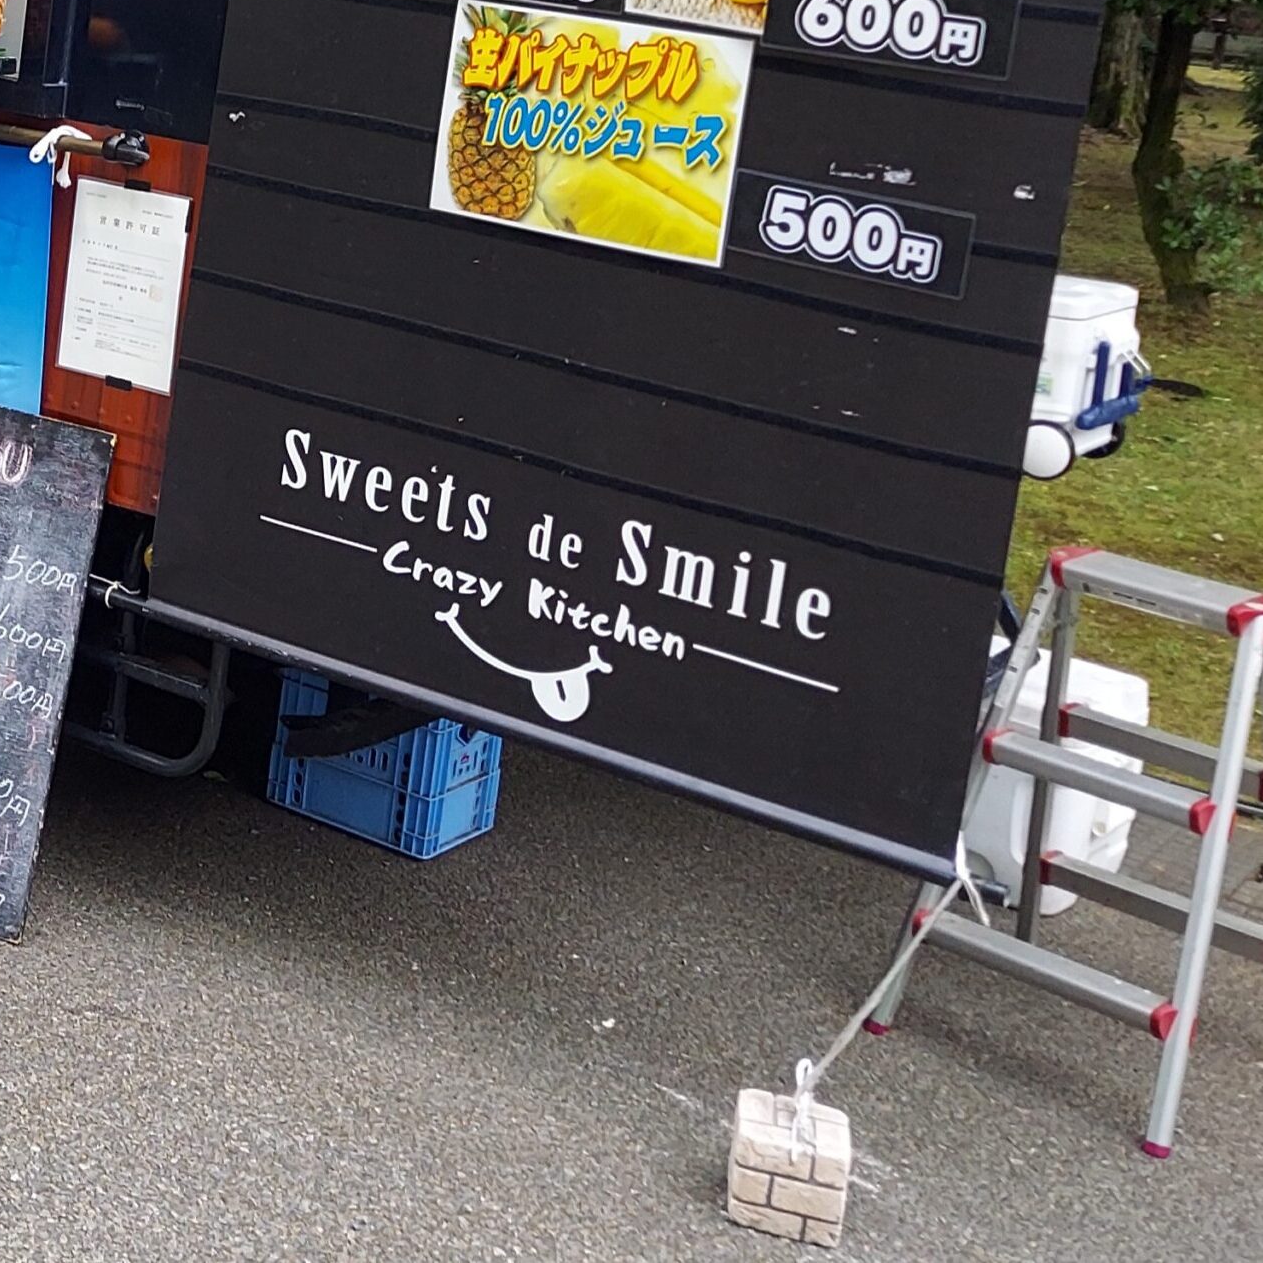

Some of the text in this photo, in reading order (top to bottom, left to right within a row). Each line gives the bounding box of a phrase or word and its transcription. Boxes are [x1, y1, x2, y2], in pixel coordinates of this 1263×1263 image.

[463, 28, 701, 102] 生パイナップル
[483, 96, 725, 169] 100%ジュース
[764, 190, 937, 279] 500円
[2, 544, 77, 595] 500円
[280, 428, 833, 640] Sweets de Smile
[382, 541, 685, 660] Crazy Kitchen
